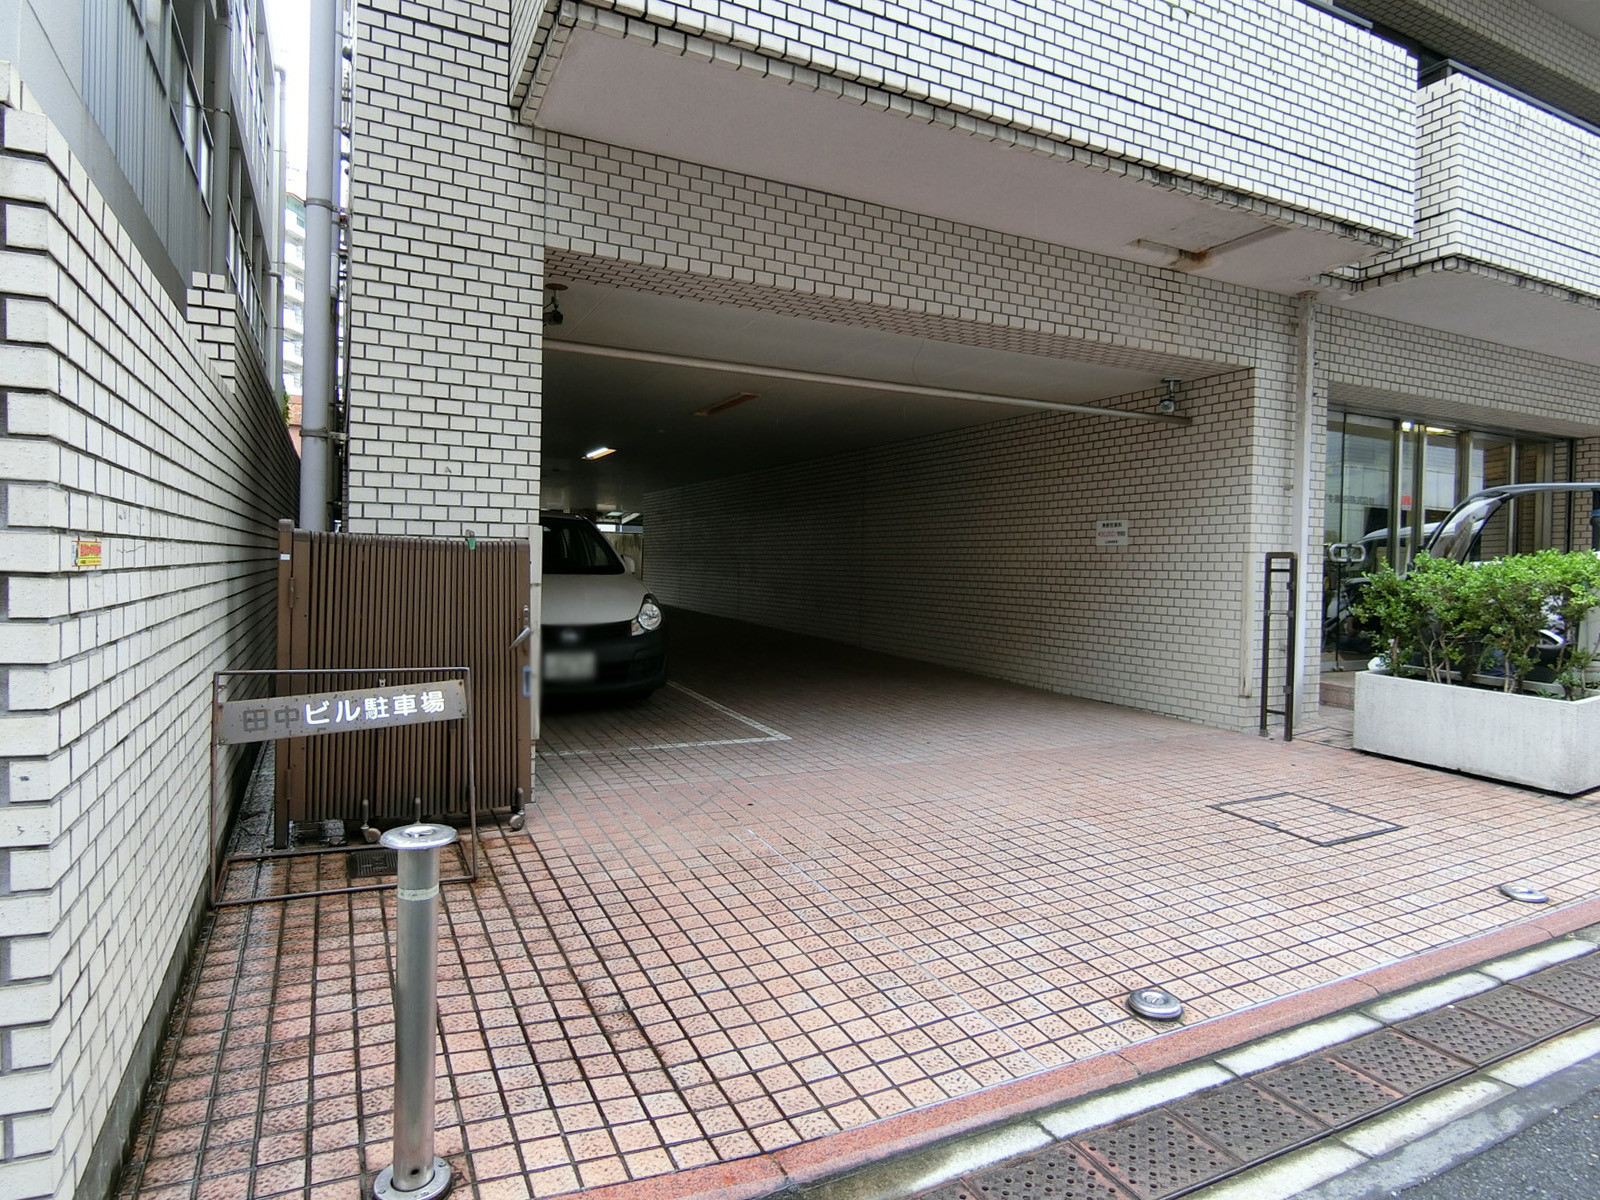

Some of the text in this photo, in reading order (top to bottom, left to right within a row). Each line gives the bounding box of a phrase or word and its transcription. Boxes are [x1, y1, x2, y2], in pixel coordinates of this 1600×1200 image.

[242, 690, 445, 733] 田中ビル駐車場
